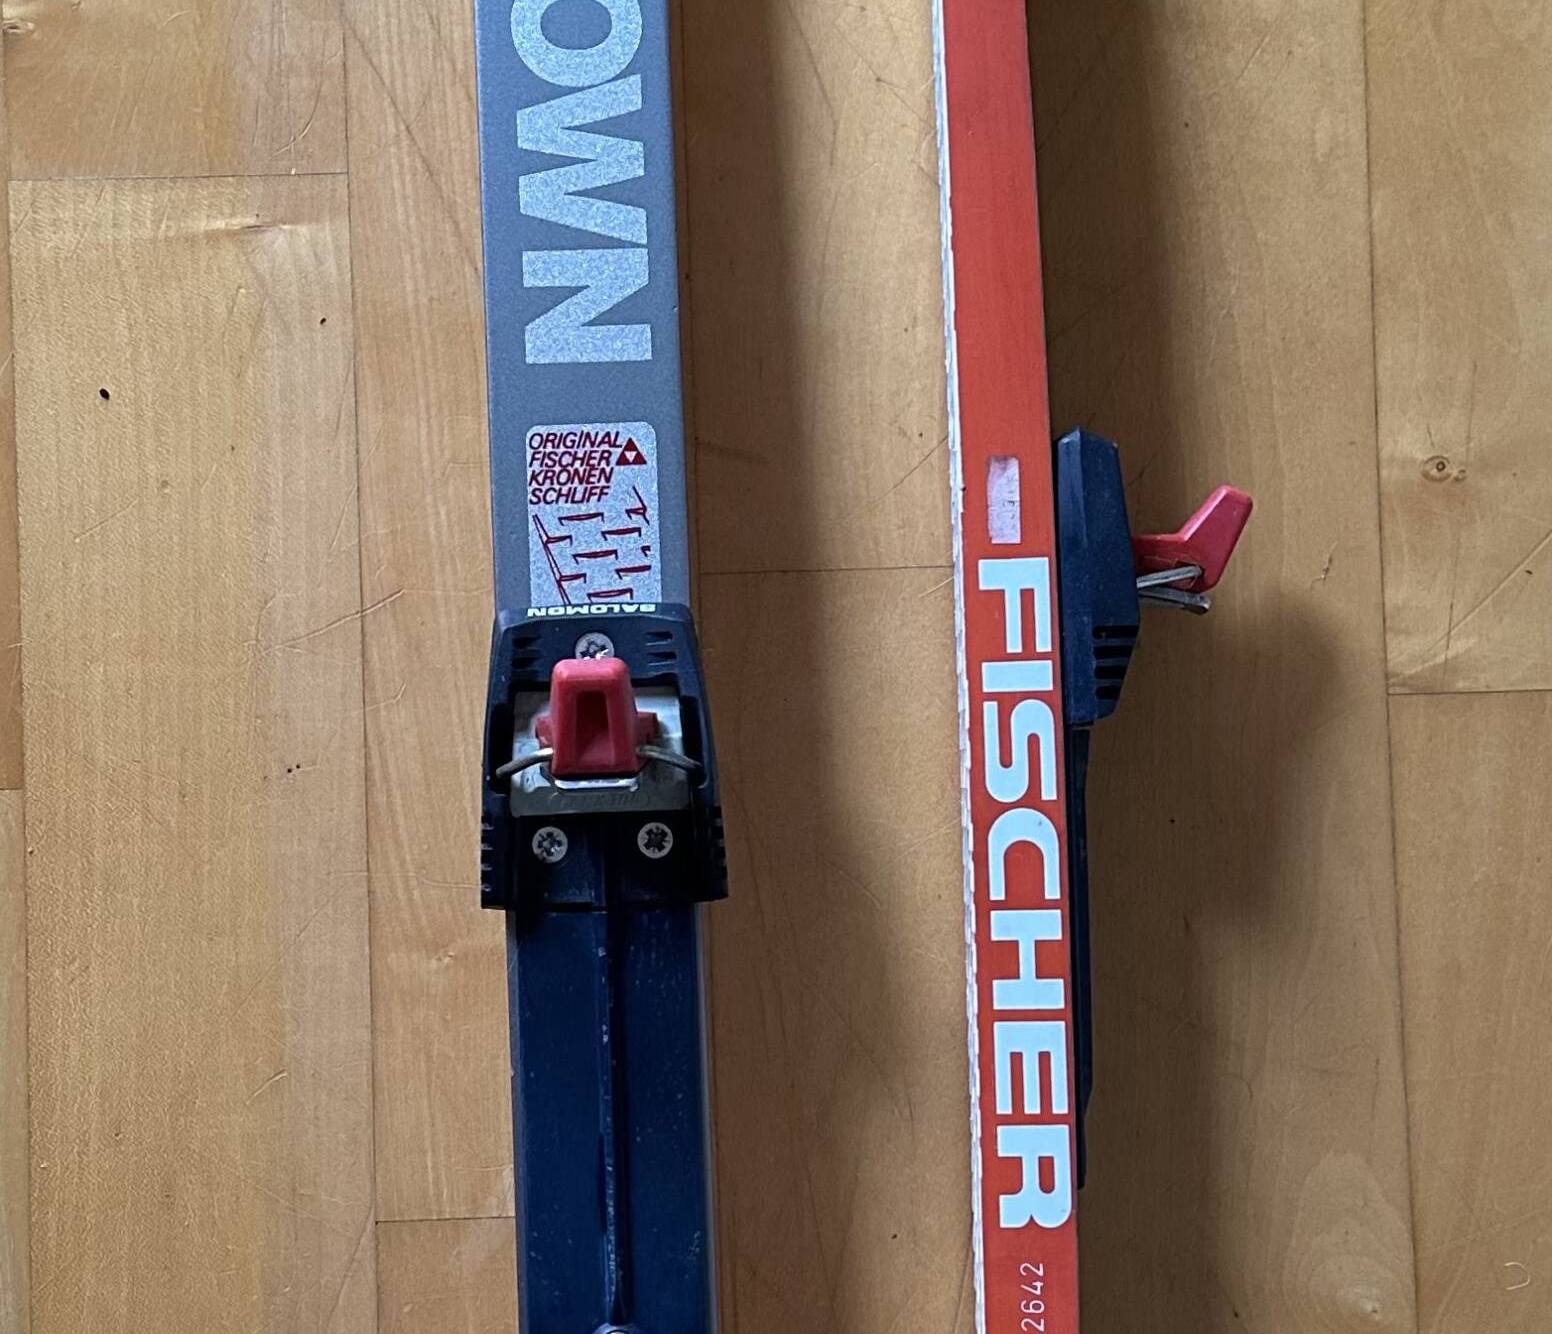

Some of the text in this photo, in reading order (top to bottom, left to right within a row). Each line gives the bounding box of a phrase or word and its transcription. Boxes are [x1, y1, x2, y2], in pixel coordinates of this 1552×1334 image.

[529, 430, 623, 450] ORIGINAL
[528, 450, 612, 468] FISCHER
[528, 467, 614, 486] KRONEN
[528, 486, 610, 505] SCHLIFF
[527, 604, 656, 617] SALOMON
[977, 557, 1074, 1230] FISCHER
